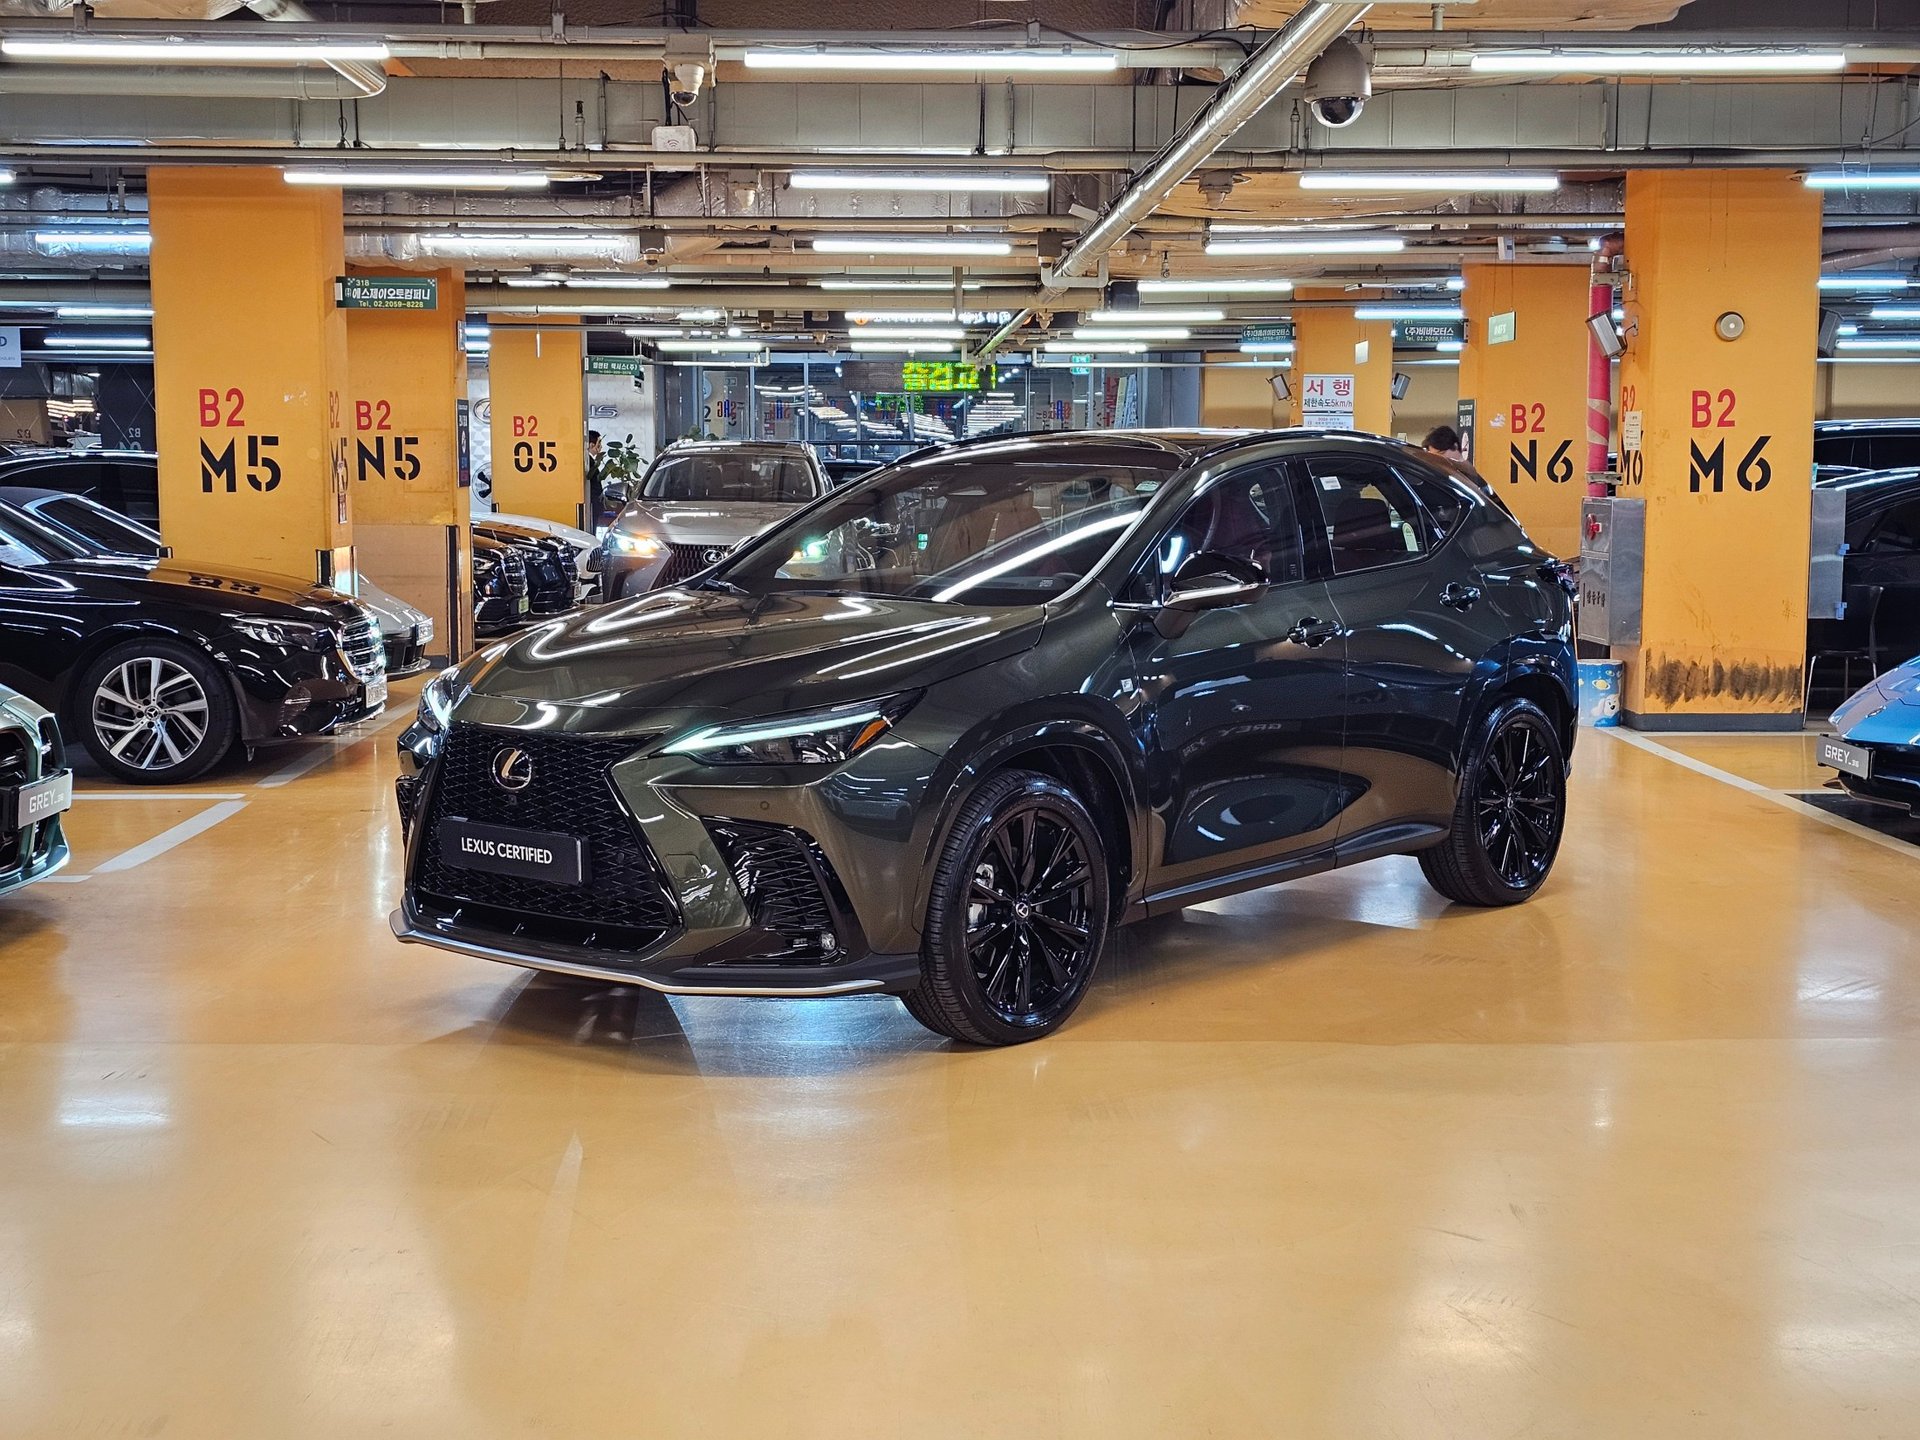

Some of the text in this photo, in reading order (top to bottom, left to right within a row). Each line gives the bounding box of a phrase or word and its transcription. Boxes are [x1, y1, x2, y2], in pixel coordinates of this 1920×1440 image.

[355, 279, 370, 287] 318
[199, 388, 245, 427] B2
[327, 391, 340, 429] B2
[356, 400, 391, 430] B2
[513, 415, 538, 437] B2
[1511, 402, 1546, 433] B2
[1691, 388, 1736, 428] B2
[200, 435, 281, 492] M5
[356, 435, 421, 481] N5
[1510, 439, 1574, 483] N6
[1689, 435, 1772, 492] M6
[461, 836, 553, 864] LEXUS CERTIFIED
